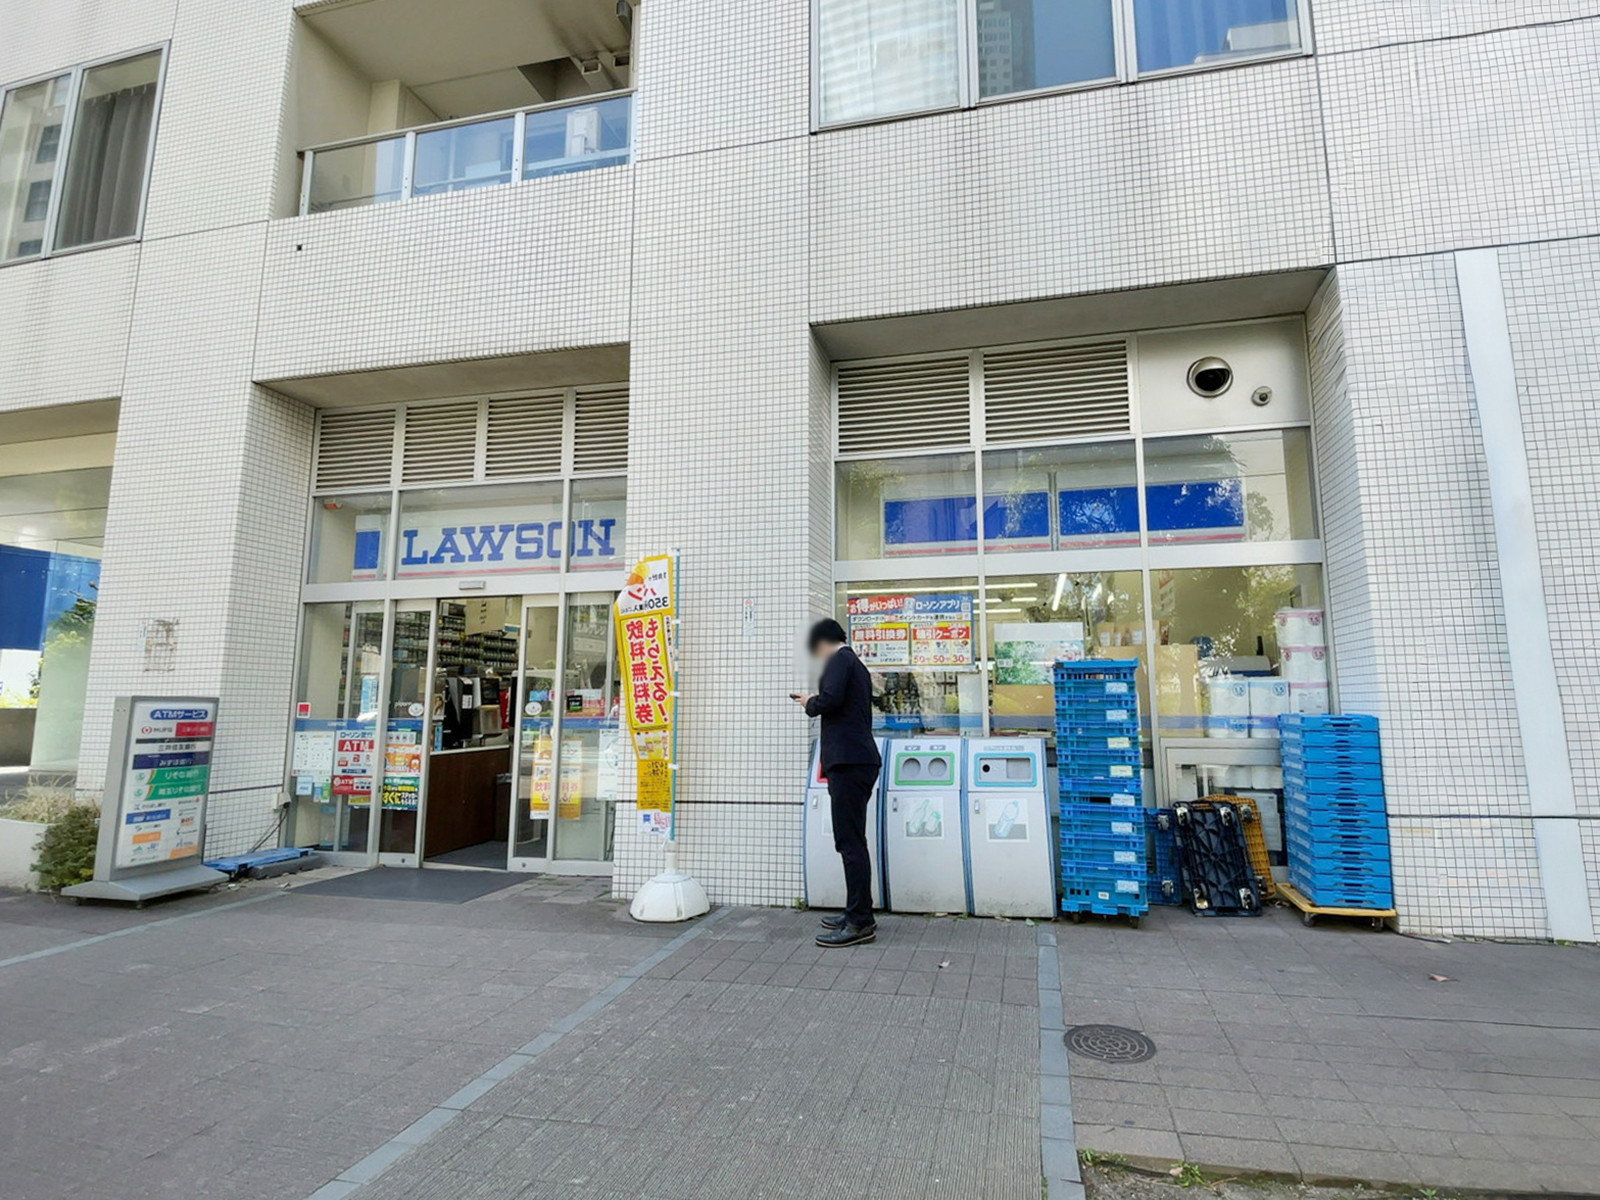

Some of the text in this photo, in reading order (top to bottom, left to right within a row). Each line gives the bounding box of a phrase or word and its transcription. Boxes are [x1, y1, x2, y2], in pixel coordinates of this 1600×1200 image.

[401, 518, 616, 565] LAWSON
[915, 599, 960, 610] ローソンアプリ
[153, 710, 206, 719] ATMサービス
[343, 741, 370, 752] ATM
